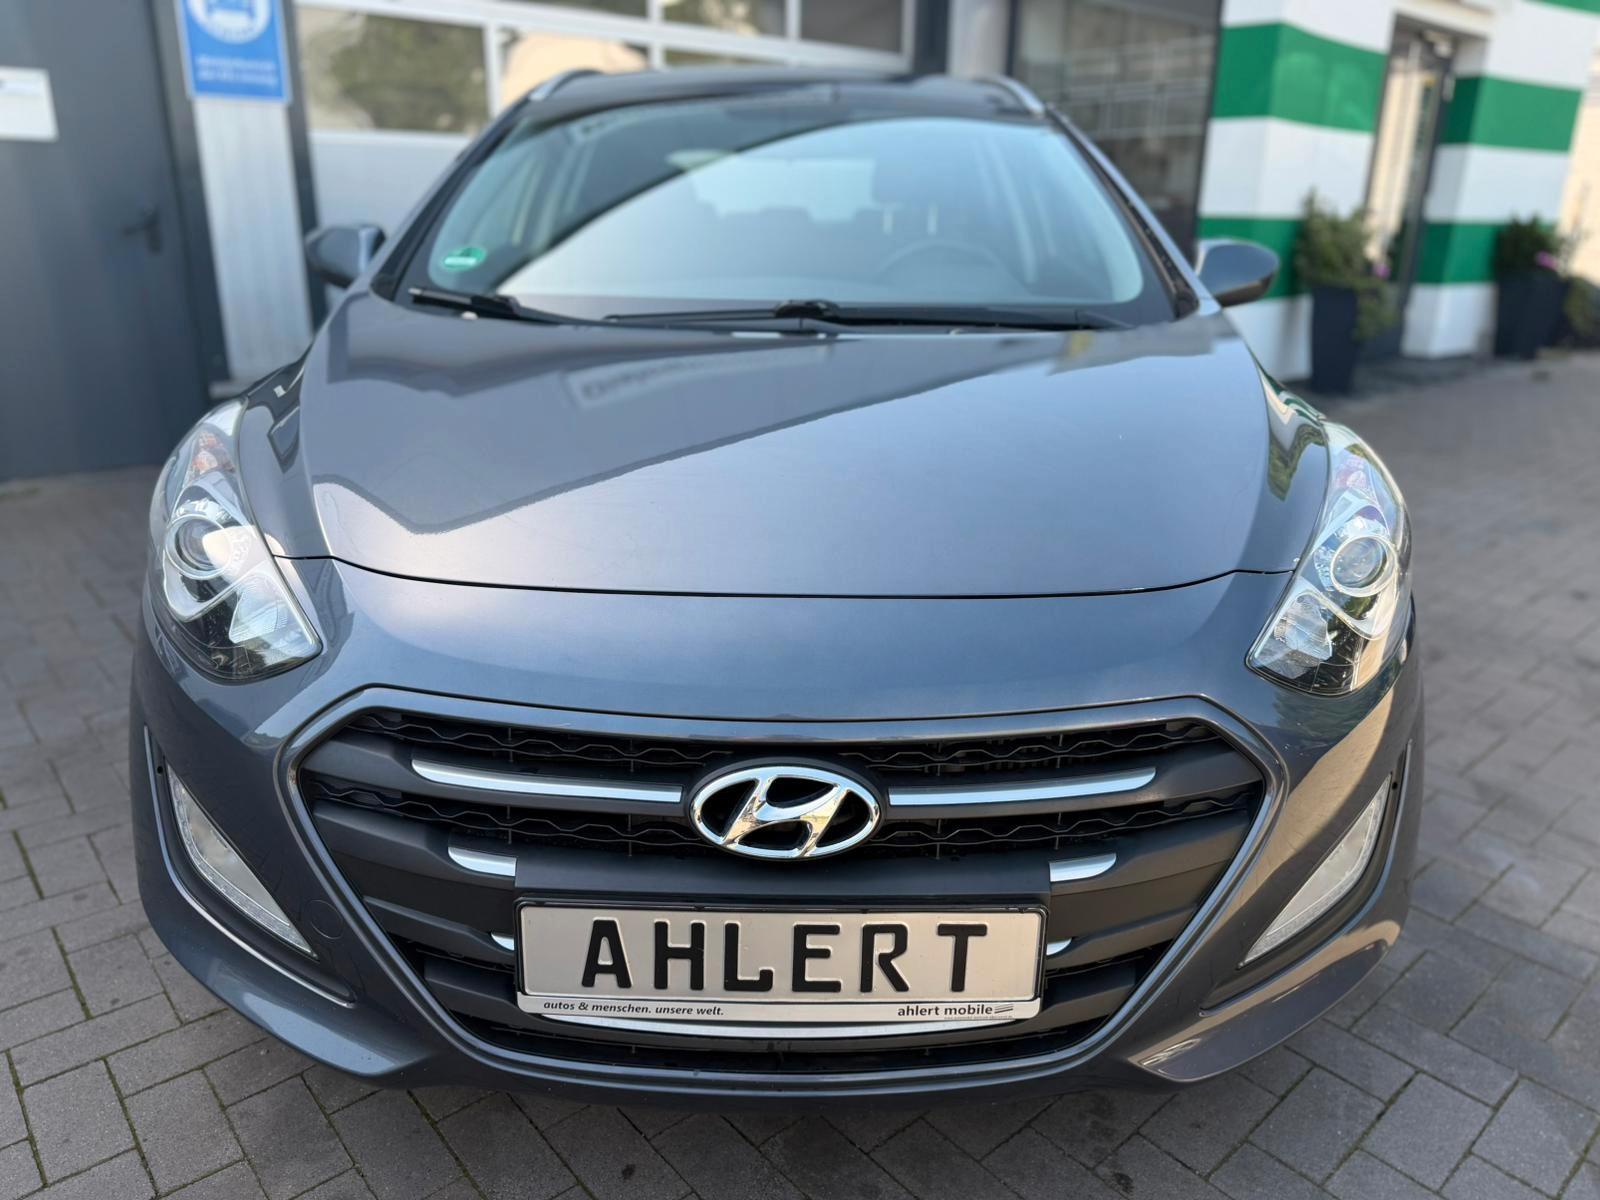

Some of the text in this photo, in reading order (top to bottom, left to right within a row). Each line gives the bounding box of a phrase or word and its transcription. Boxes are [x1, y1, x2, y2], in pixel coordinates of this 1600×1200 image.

[581, 919, 987, 992] AHLERT
[543, 1001, 724, 1016] autos & menschen. unsere welt.
[897, 1004, 993, 1017] ahlert mobile
